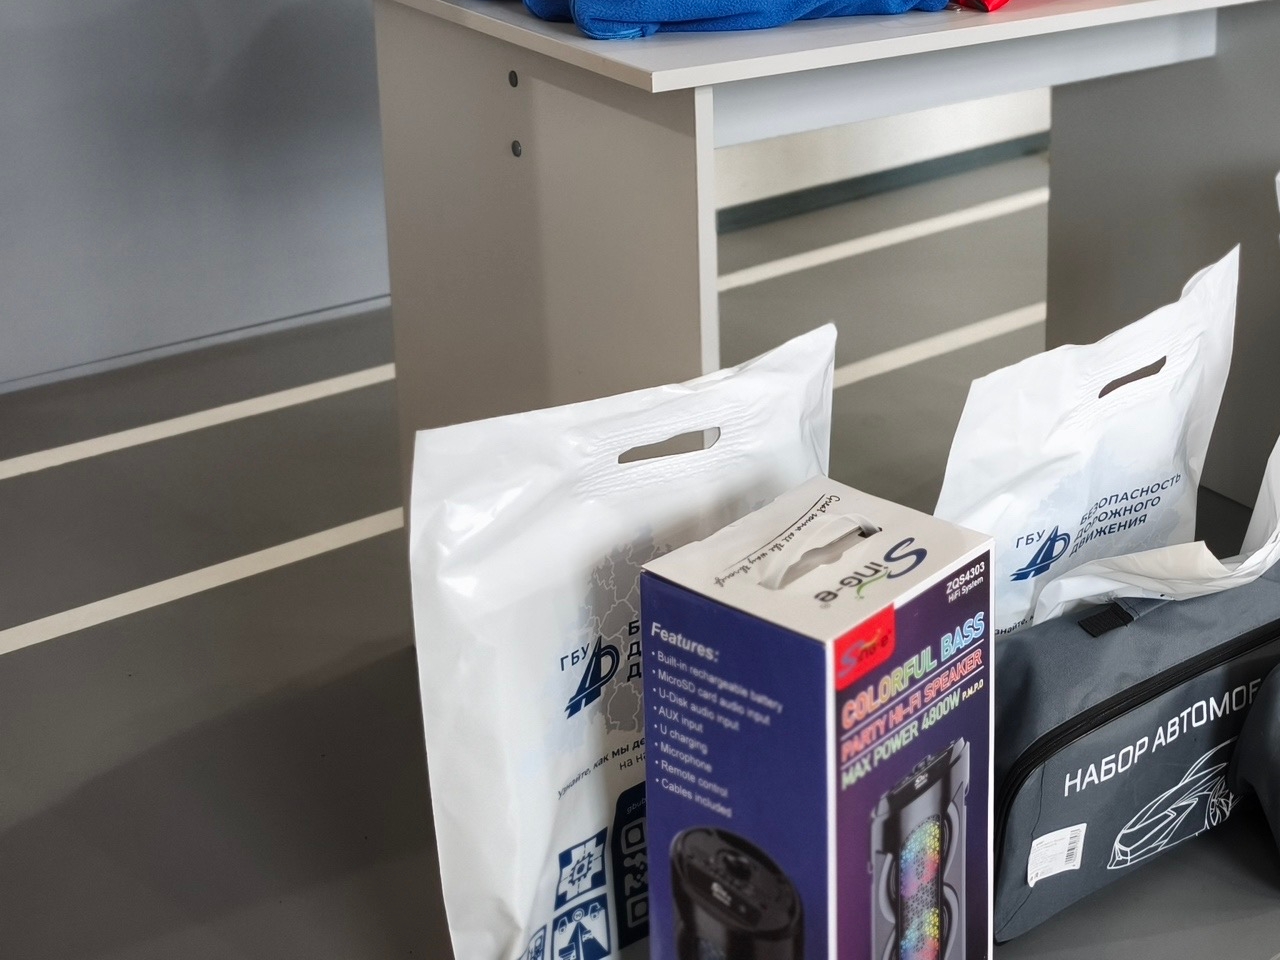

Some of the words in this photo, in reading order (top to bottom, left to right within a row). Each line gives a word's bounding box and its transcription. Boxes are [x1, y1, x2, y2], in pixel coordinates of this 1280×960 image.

[1075, 496, 1161, 541] ДОРОЖНОГО
[1080, 473, 1181, 525] БЕЗОПАСНОСТЬ
[1016, 529, 1046, 548] ГБУ
[1069, 514, 1147, 558] ДВИЖЕНИЯ
[946, 561, 985, 594] ZQS4303
[961, 576, 984, 594] System
[560, 642, 590, 671] ГБУ
[651, 622, 719, 663] Features:
[657, 650, 688, 672] Built-in
[689, 663, 749, 697] rechargeable
[841, 645, 937, 730] COLORFUL
[941, 611, 985, 662] BASS
[658, 669, 696, 693] MicroSD
[698, 688, 717, 703] card
[720, 696, 745, 715] audio
[747, 708, 771, 726] input
[658, 687, 688, 708] U-Disk
[690, 701, 715, 721] audio
[716, 714, 740, 732] input
[841, 715, 888, 763] PARTY
[888, 690, 922, 730] HI-FI
[924, 649, 983, 704] SPEAKER
[658, 706, 680, 722] AUX
[681, 715, 704, 734] input
[660, 724, 668, 735] U
[669, 727, 708, 755] charging
[841, 754, 872, 790] MAX
[873, 720, 919, 768] POWER
[921, 688, 961, 731] 4800W
[593, 753, 609, 769] как
[611, 745, 630, 758] мы
[619, 758, 633, 771] на
[660, 742, 712, 773] Microphone
[1064, 736, 1149, 797] НАБОР
[661, 759, 696, 783] Remote
[697, 776, 729, 798] control
[661, 778, 693, 800] Cables
[695, 794, 733, 819] included
